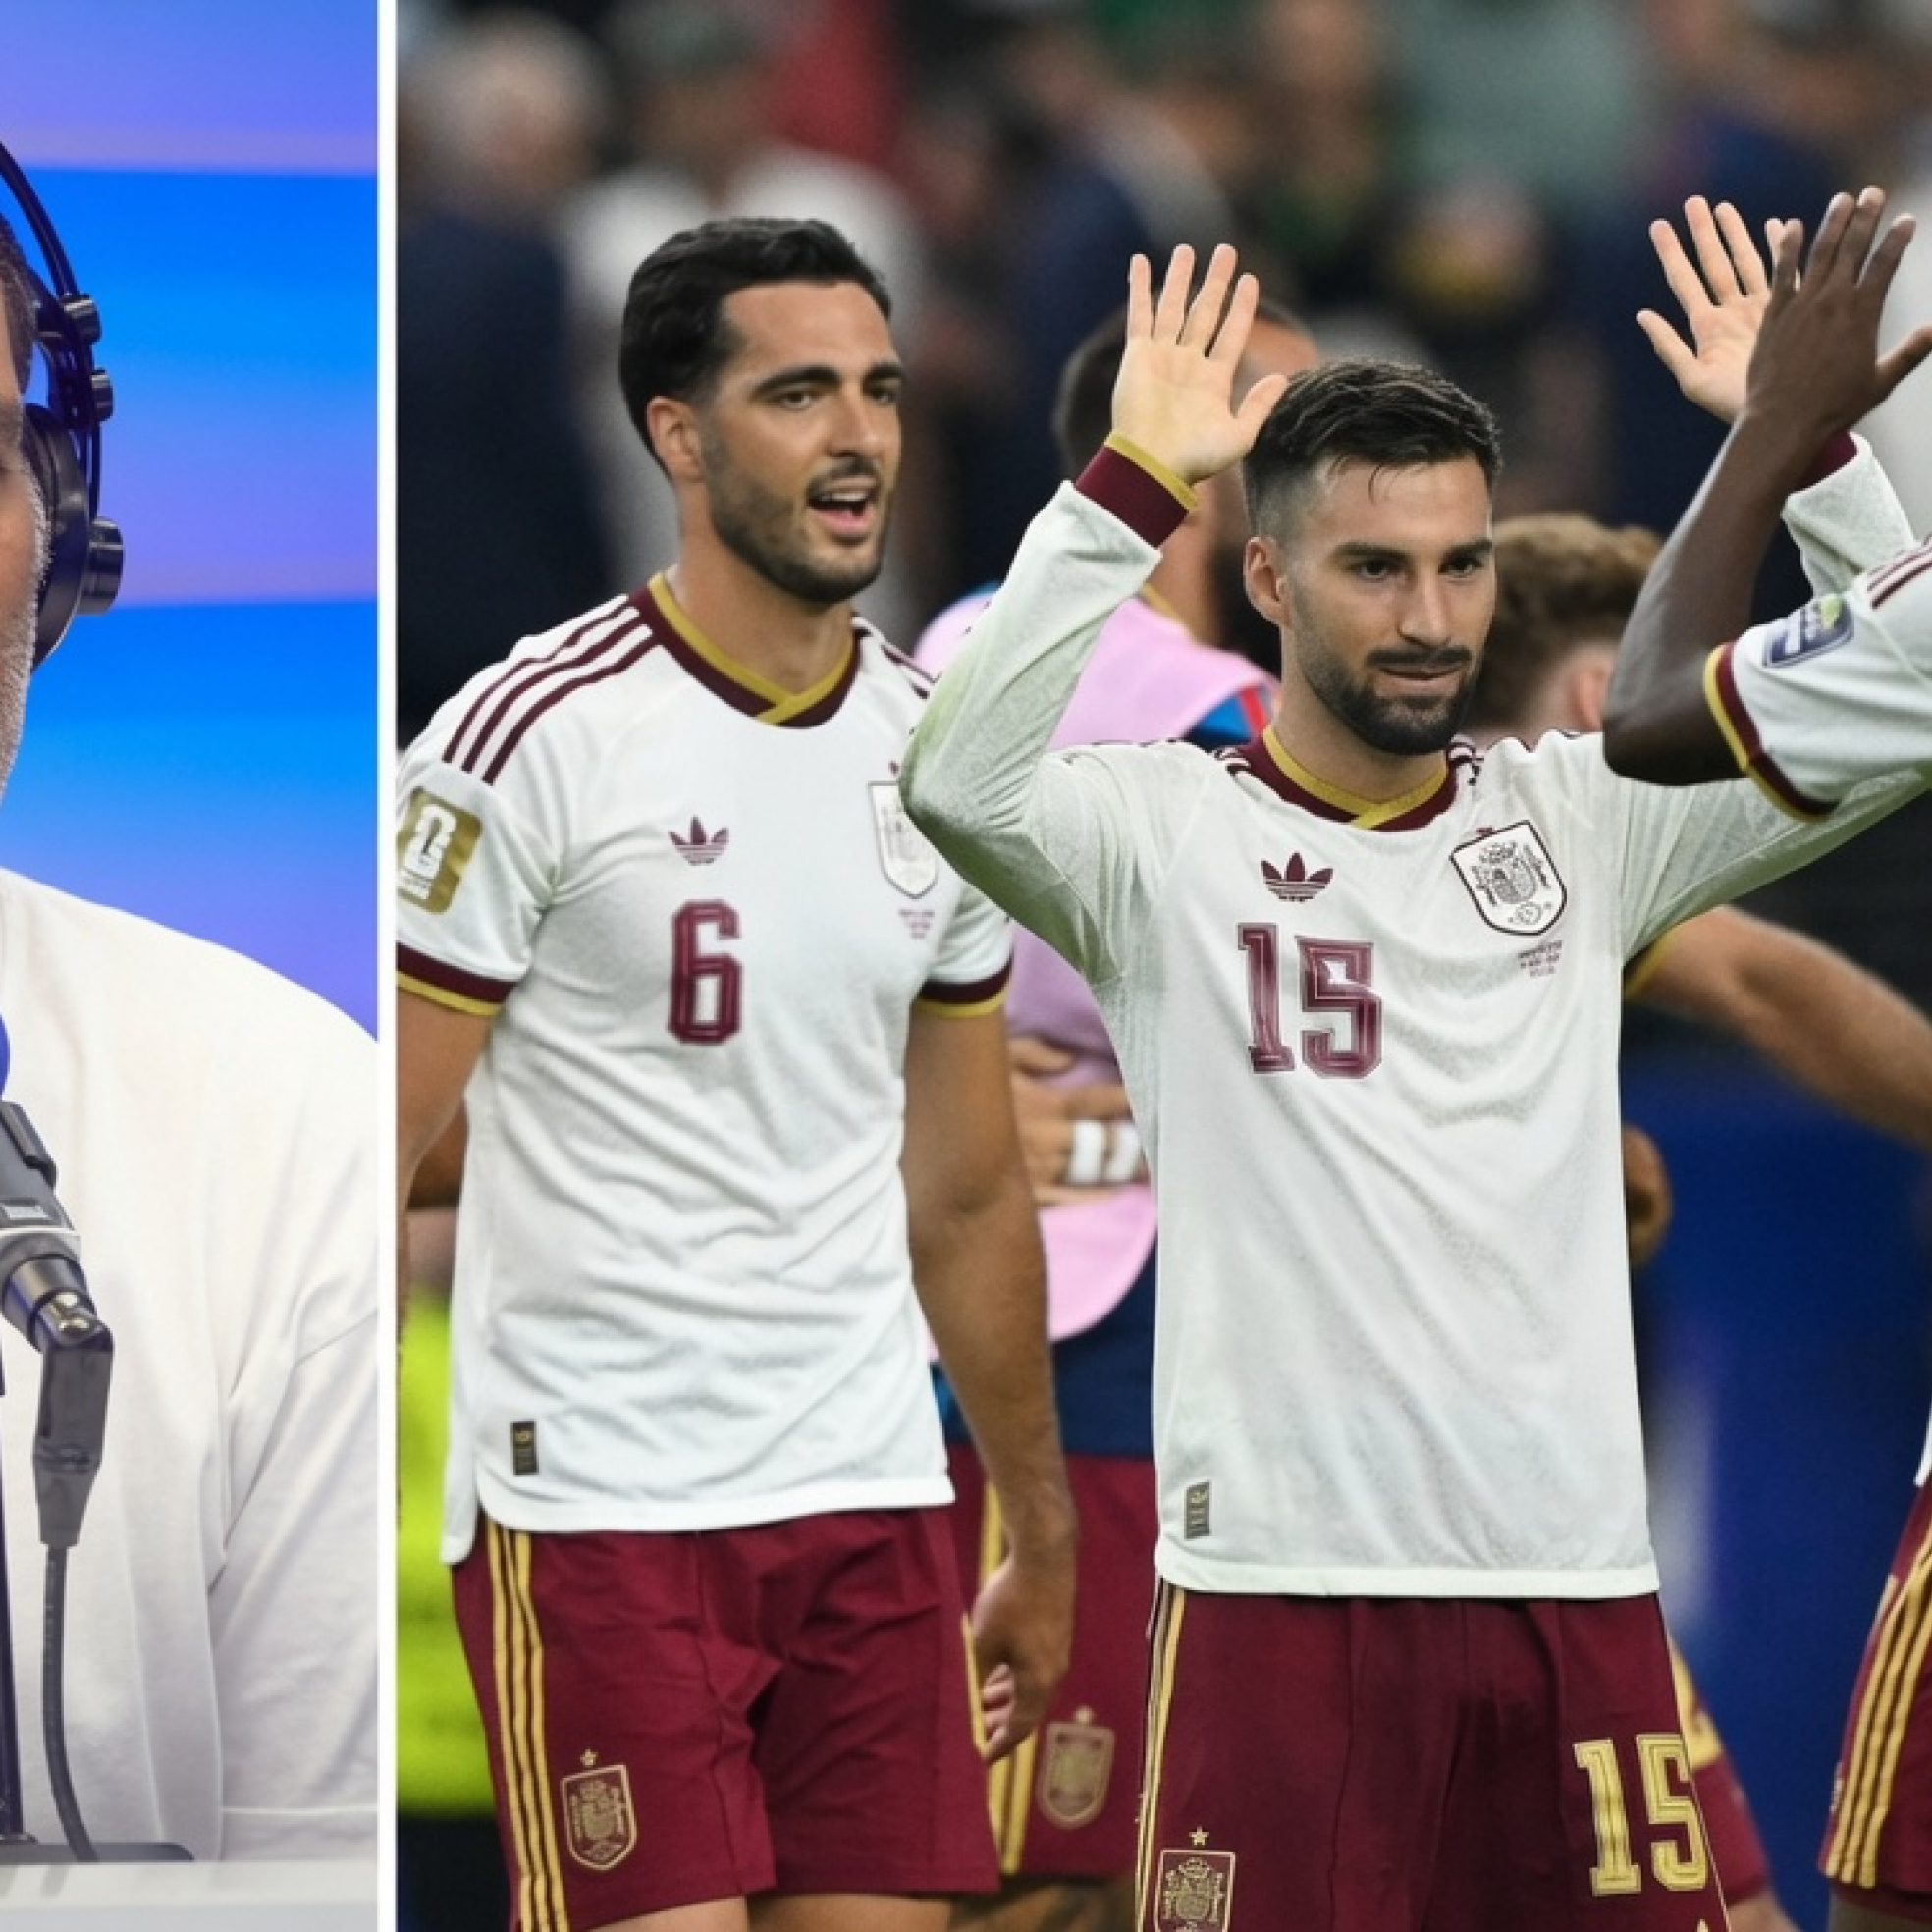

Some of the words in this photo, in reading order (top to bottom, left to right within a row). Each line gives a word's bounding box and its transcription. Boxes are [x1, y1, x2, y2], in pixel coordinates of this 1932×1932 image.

[668, 899, 743, 1046] 6
[1238, 923, 1382, 1079] 15
[1573, 1734, 1708, 1896] 15
